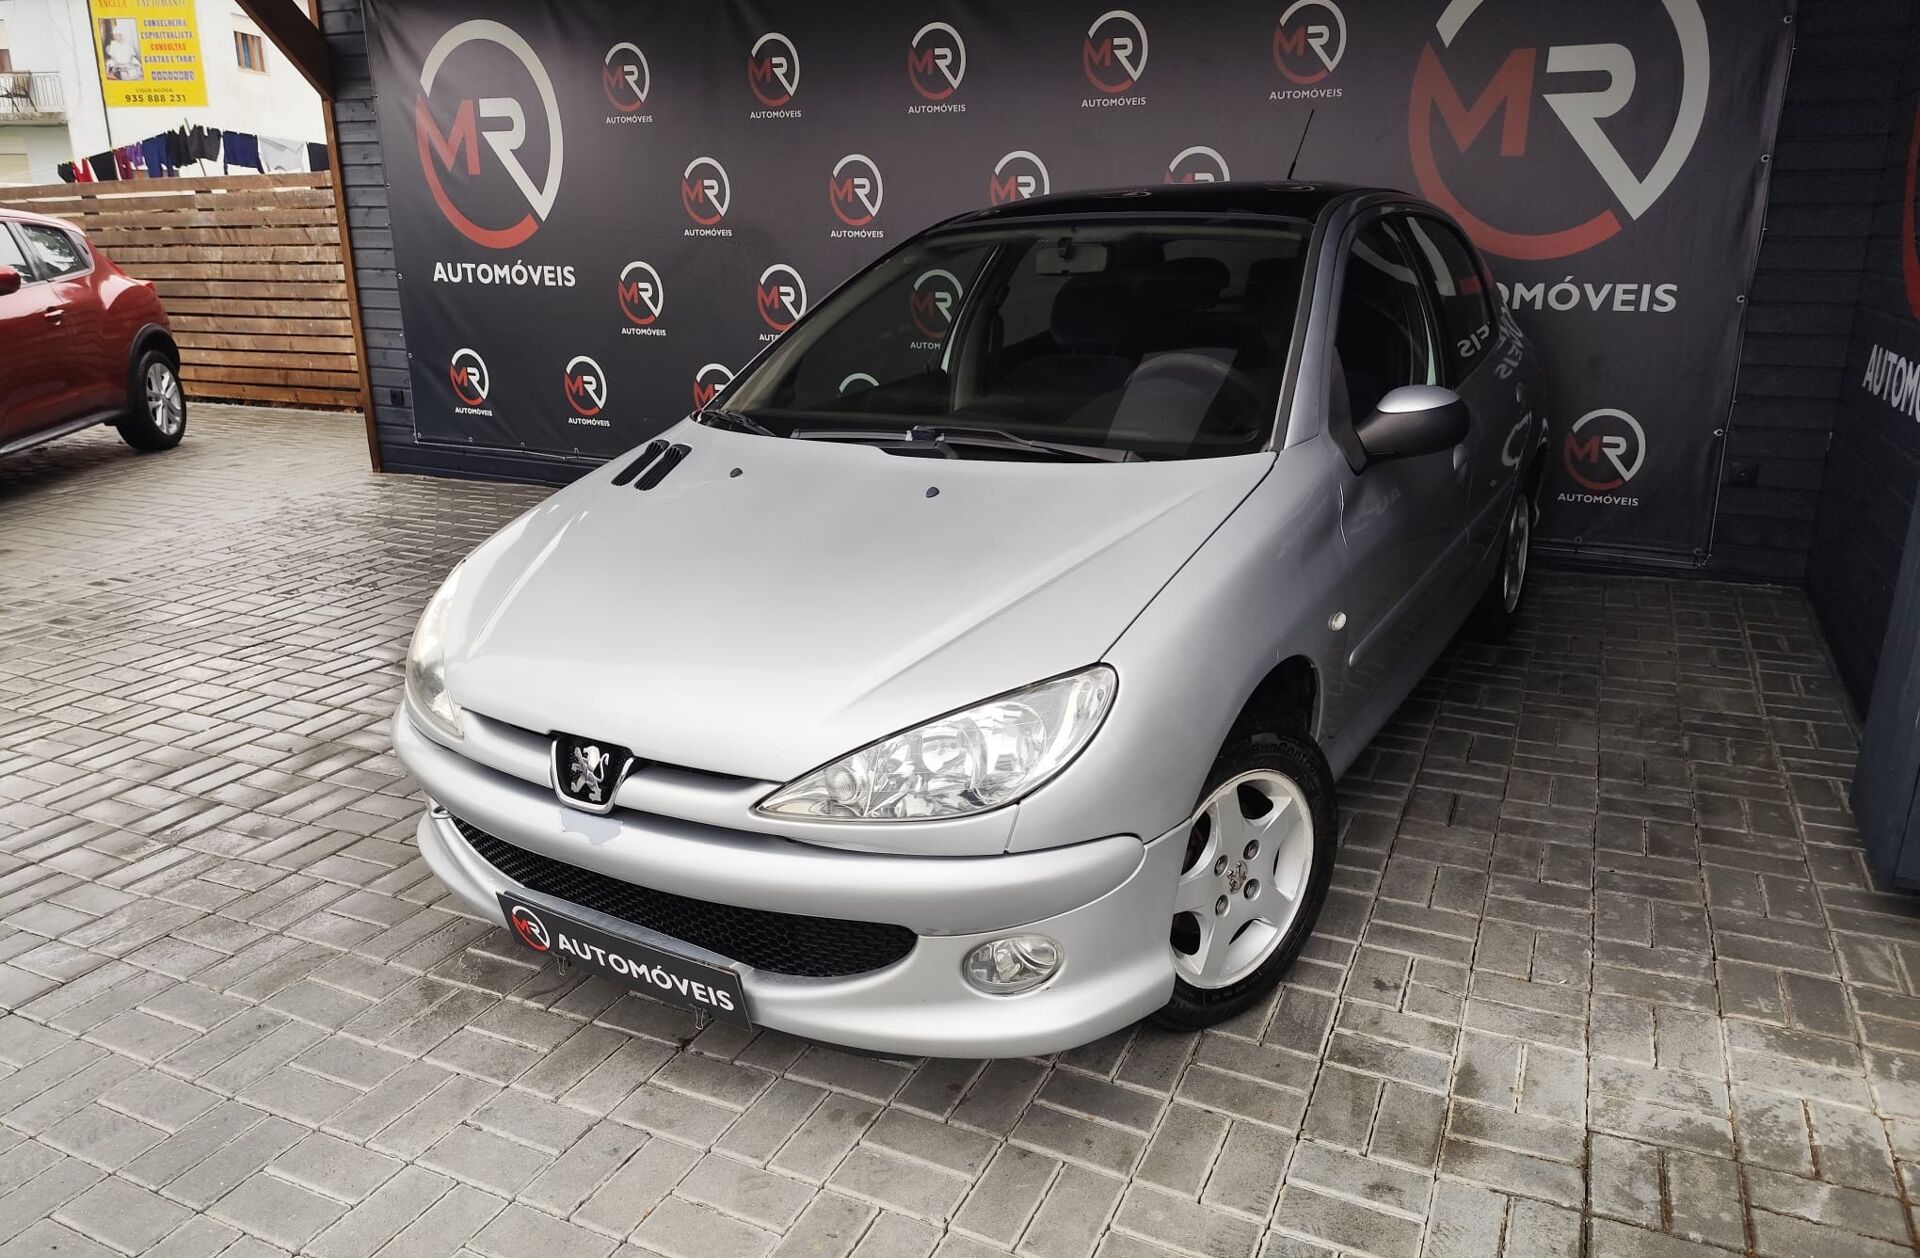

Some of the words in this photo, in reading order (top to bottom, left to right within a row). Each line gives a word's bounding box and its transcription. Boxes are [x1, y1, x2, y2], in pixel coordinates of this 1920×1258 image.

[125, 94, 144, 103] 935
[147, 94, 167, 103] 888
[170, 94, 187, 103] 231
[1269, 87, 1343, 100] AUTOMÓVEIS
[1081, 96, 1147, 108] AUTOMÓVEIS
[750, 109, 802, 119] AUTOMÓVEIS
[908, 104, 966, 114] AUTOMÓVEIS
[605, 115, 653, 124] AUTOMÓVEIS
[684, 228, 733, 237] AUTOMÓVEIS
[830, 228, 884, 239] AUTOMÓVEIS
[433, 259, 576, 288] AUTOMÓVEIS
[621, 327, 667, 336] AUTOMÓVEIS
[455, 406, 493, 416] AUTOMÓVEIS
[568, 417, 611, 427] AUTOMÓVEIS
[1557, 492, 1639, 507] AUTOMÓVEIS
[558, 933, 735, 1011] AUTOMÓVEIS
